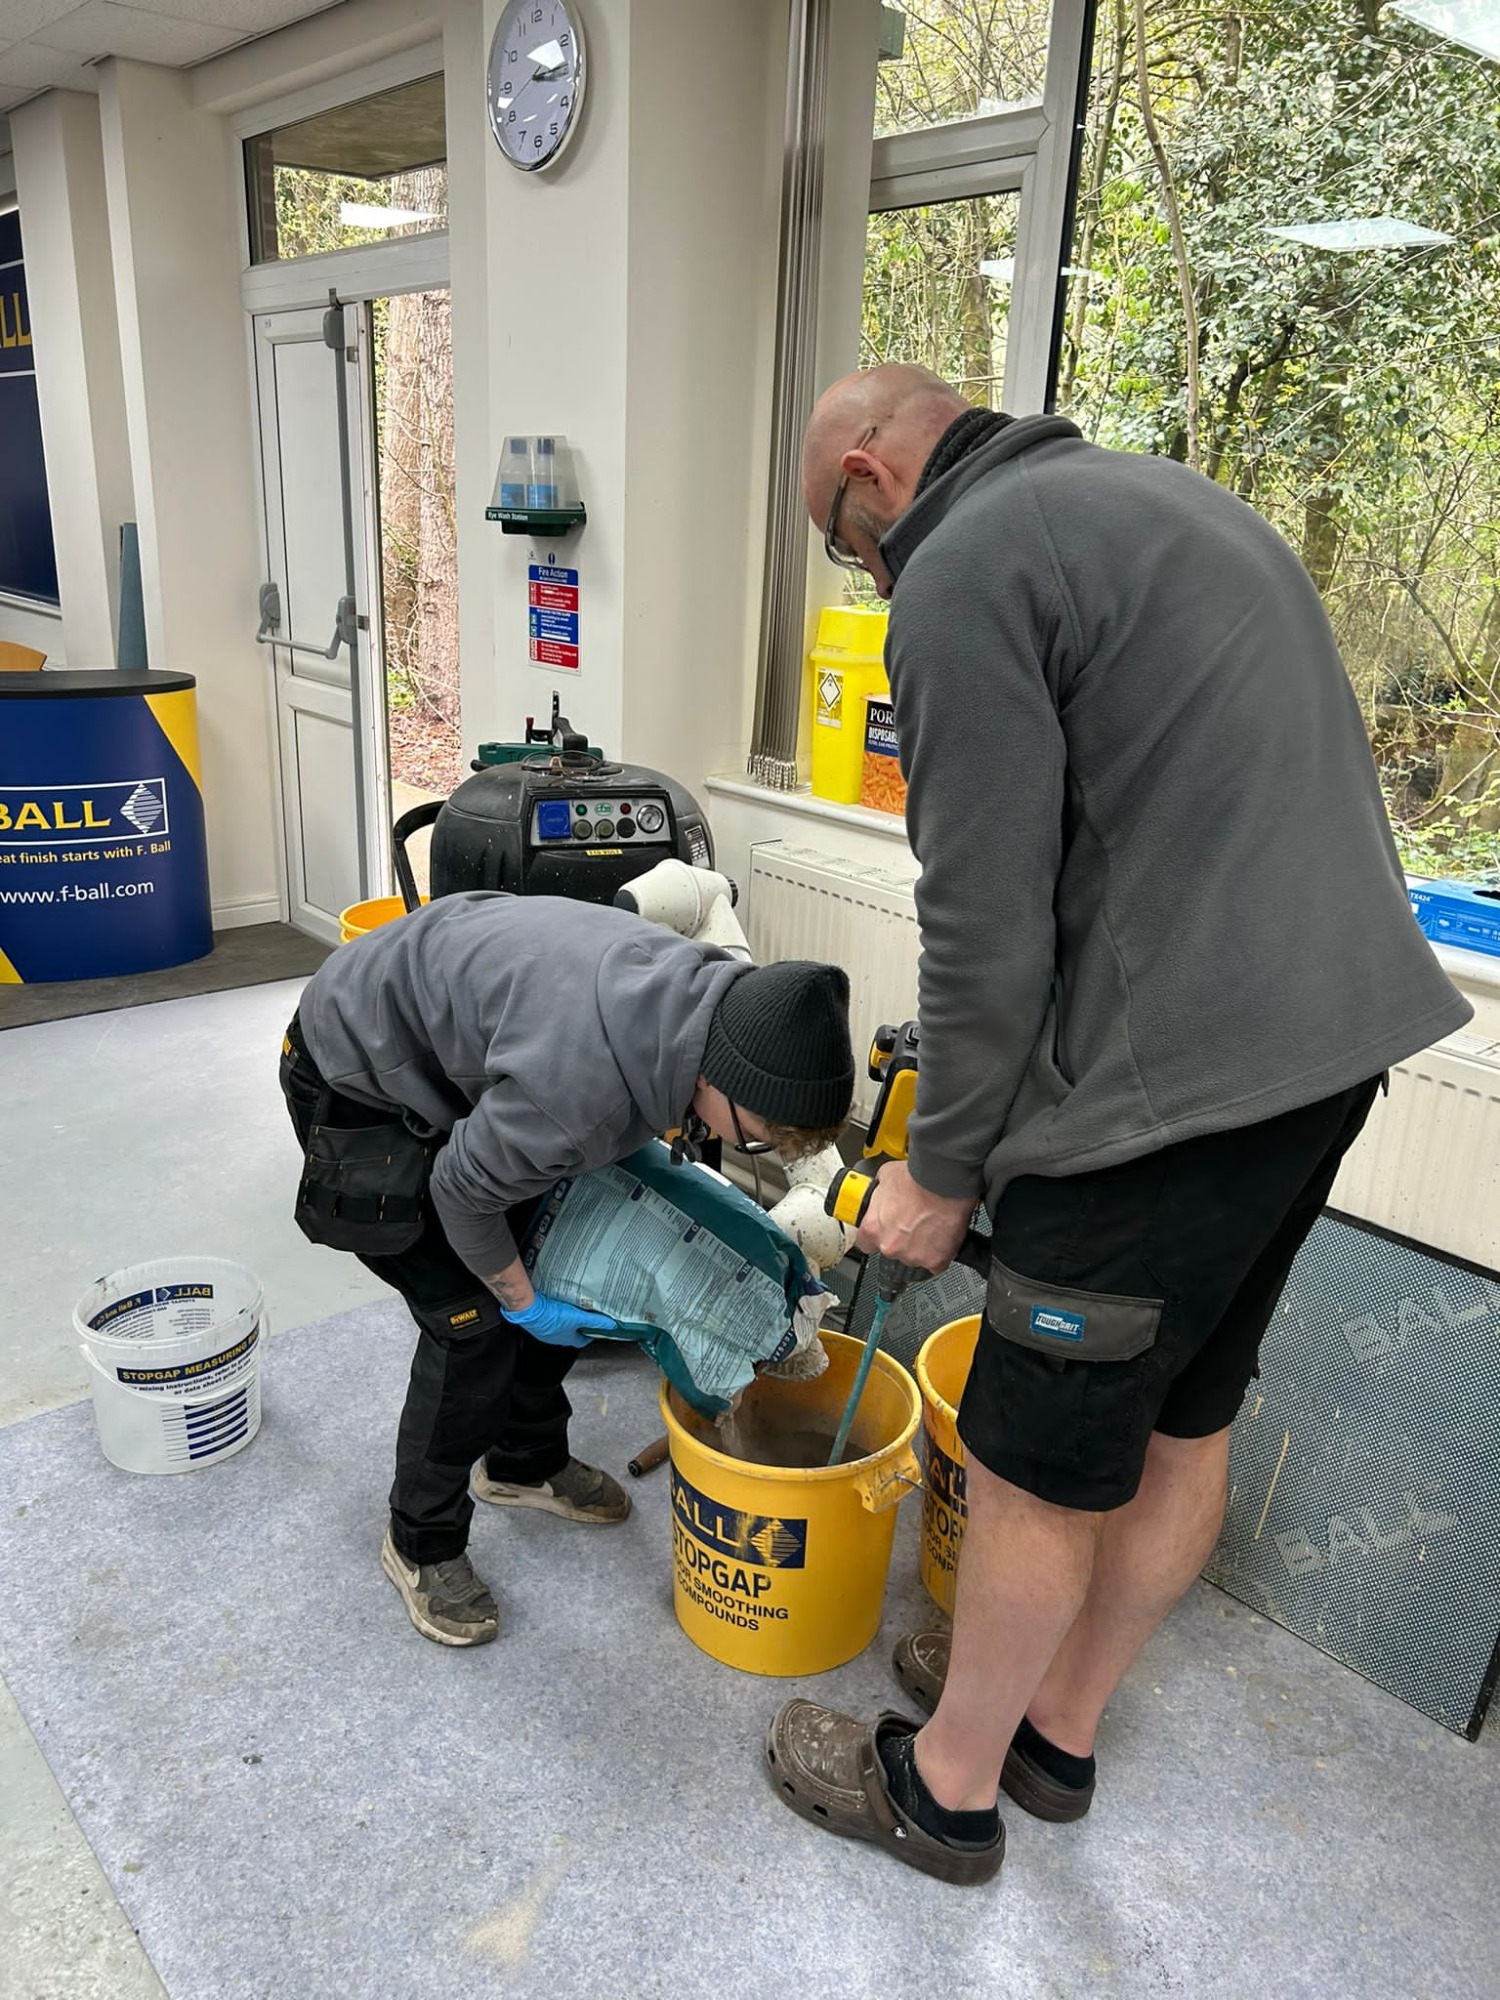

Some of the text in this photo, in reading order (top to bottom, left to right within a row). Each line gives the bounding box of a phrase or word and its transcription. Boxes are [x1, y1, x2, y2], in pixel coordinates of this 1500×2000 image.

[531, 9, 543, 24] 12
[560, 33, 569, 47] 2
[507, 50, 518, 63] 10
[503, 81, 512, 94] 9
[560, 95, 569, 108] 4
[508, 110, 516, 123] 8
[550, 122, 558, 136] 5
[518, 130, 528, 143] 7
[534, 135, 543, 148] 6
[488, 511, 497, 520] Eye
[512, 513, 528, 521] Station
[538, 566, 568, 579] Fire Action
[18, 851, 58, 864] finish
[62, 850, 100, 862] starts
[103, 846, 133, 860] with
[136, 845, 148, 856] F.
[150, 840, 171, 854] Ball
[0, 880, 154, 904] www.f-ball.com
[122, 1369, 181, 1381] STOPGAP
[184, 1342, 247, 1376] MEASURING
[202, 1379, 222, 1388] sheet
[1274, 1487, 1458, 1576] BALL
[677, 1572, 759, 1631] COMPOUNDS
[694, 1577, 789, 1620] SMOOTHING
